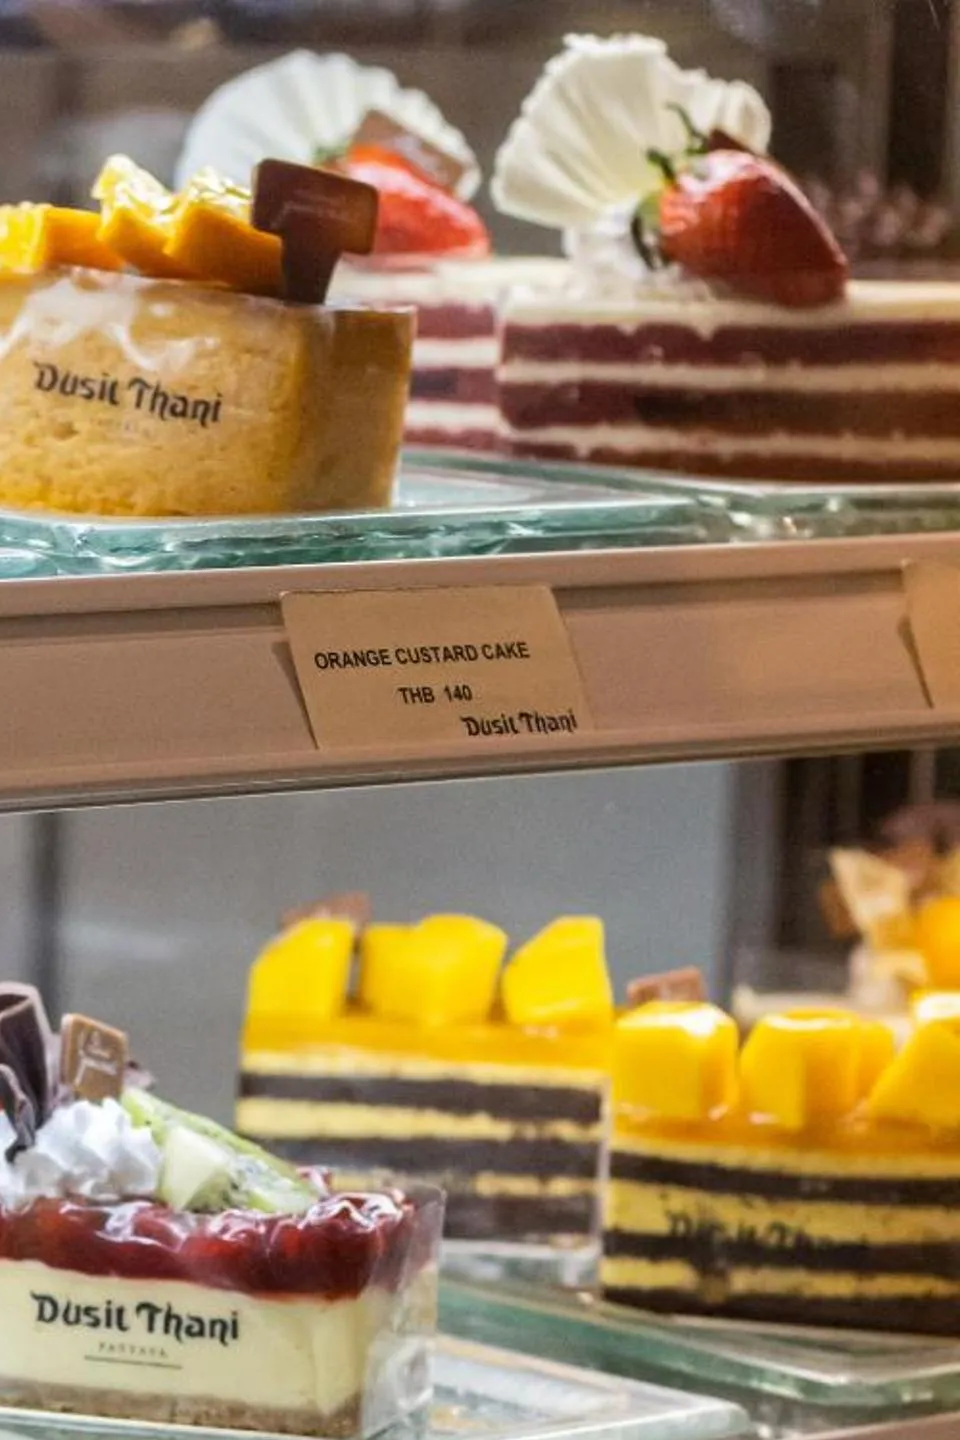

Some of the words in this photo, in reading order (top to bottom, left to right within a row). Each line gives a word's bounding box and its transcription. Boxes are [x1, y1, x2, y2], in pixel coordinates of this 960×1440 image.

[33, 361, 121, 406] Dusit
[127, 376, 223, 429] Thani
[315, 648, 392, 670] ORANGE
[395, 644, 478, 665] CUSTARD
[481, 641, 531, 660] CAKE
[398, 686, 435, 705] THB
[443, 684, 473, 702] 140
[460, 715, 520, 736] Dusit
[519, 709, 579, 735] Thani
[29, 1289, 129, 1333] Dusit
[135, 1301, 240, 1347] Thani
